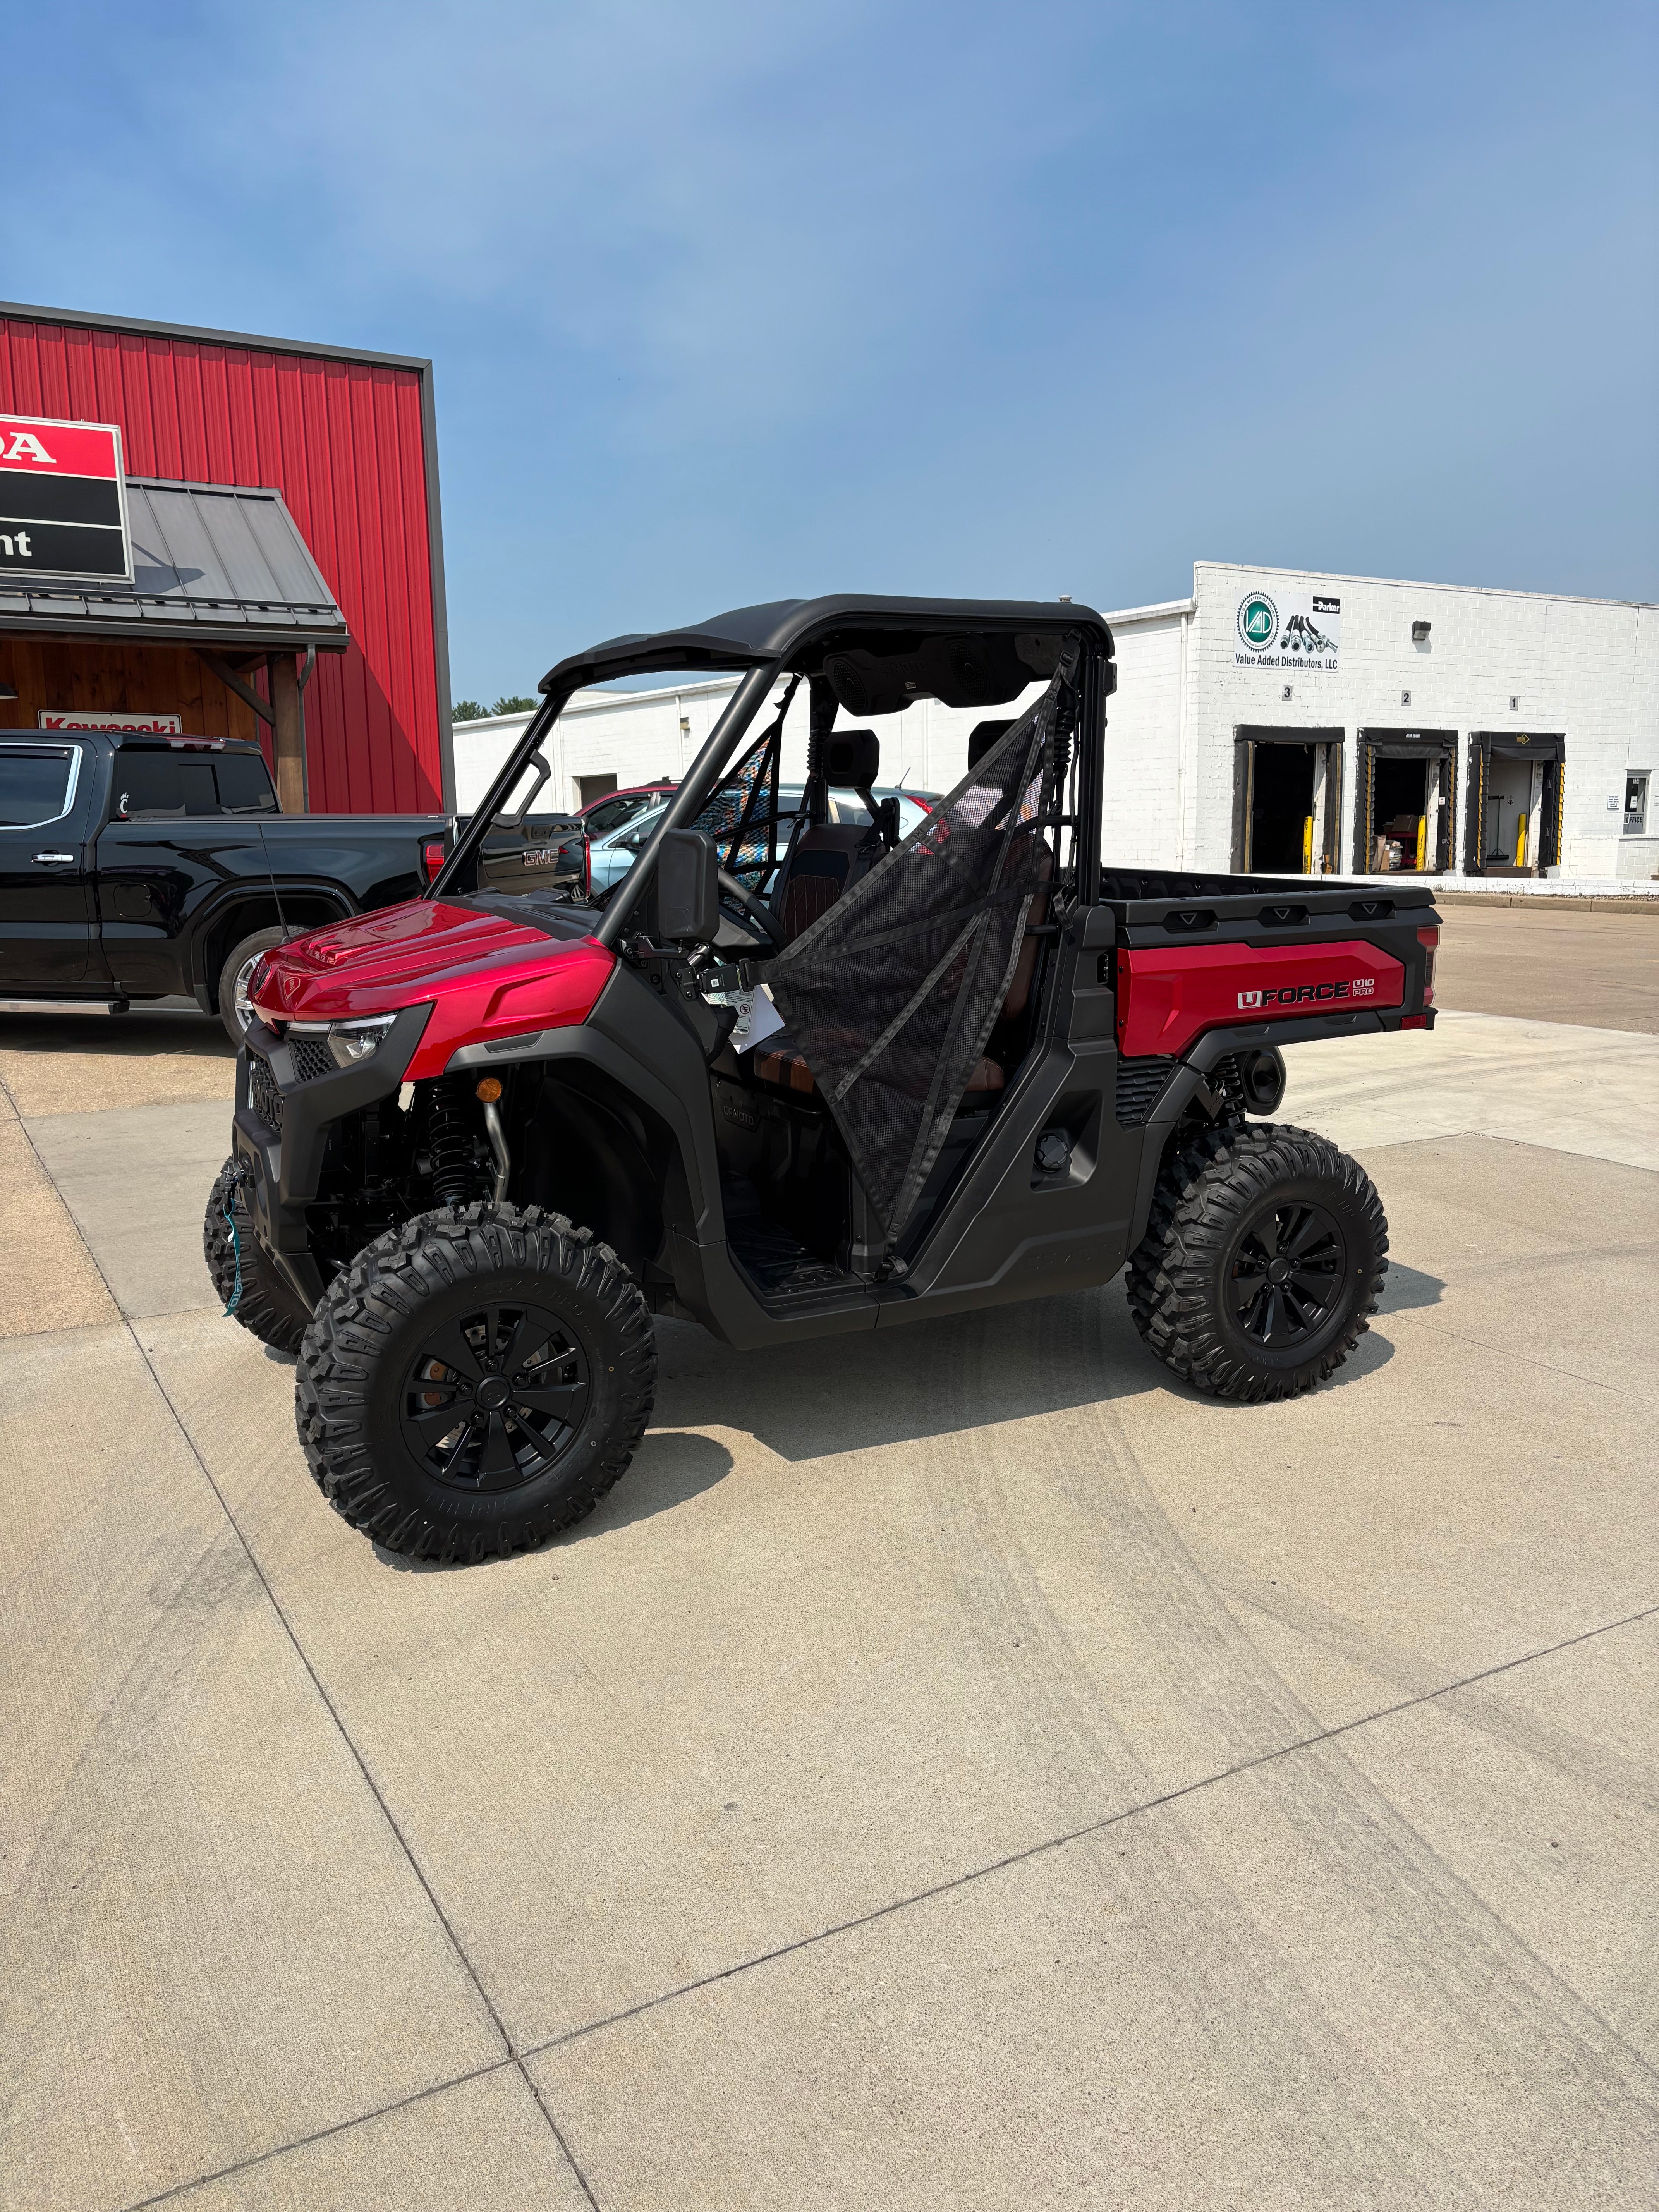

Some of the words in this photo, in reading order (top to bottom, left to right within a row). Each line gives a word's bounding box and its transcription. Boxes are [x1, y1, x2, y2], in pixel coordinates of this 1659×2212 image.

[0, 432, 57, 463] A
[1318, 601, 1340, 612] Parker
[1246, 610, 1272, 634] VAD
[1235, 653, 1255, 664] Value
[1257, 655, 1279, 666] Added
[1281, 656, 1323, 670] Distributors,
[1325, 659, 1337, 669] LLC
[1284, 687, 1291, 697] 3
[1403, 693, 1409, 702] 2
[1512, 697, 1516, 708] 1
[523, 848, 559, 866] GMC
[1353, 979, 1374, 988] U10
[1353, 987, 1374, 996] PRO
